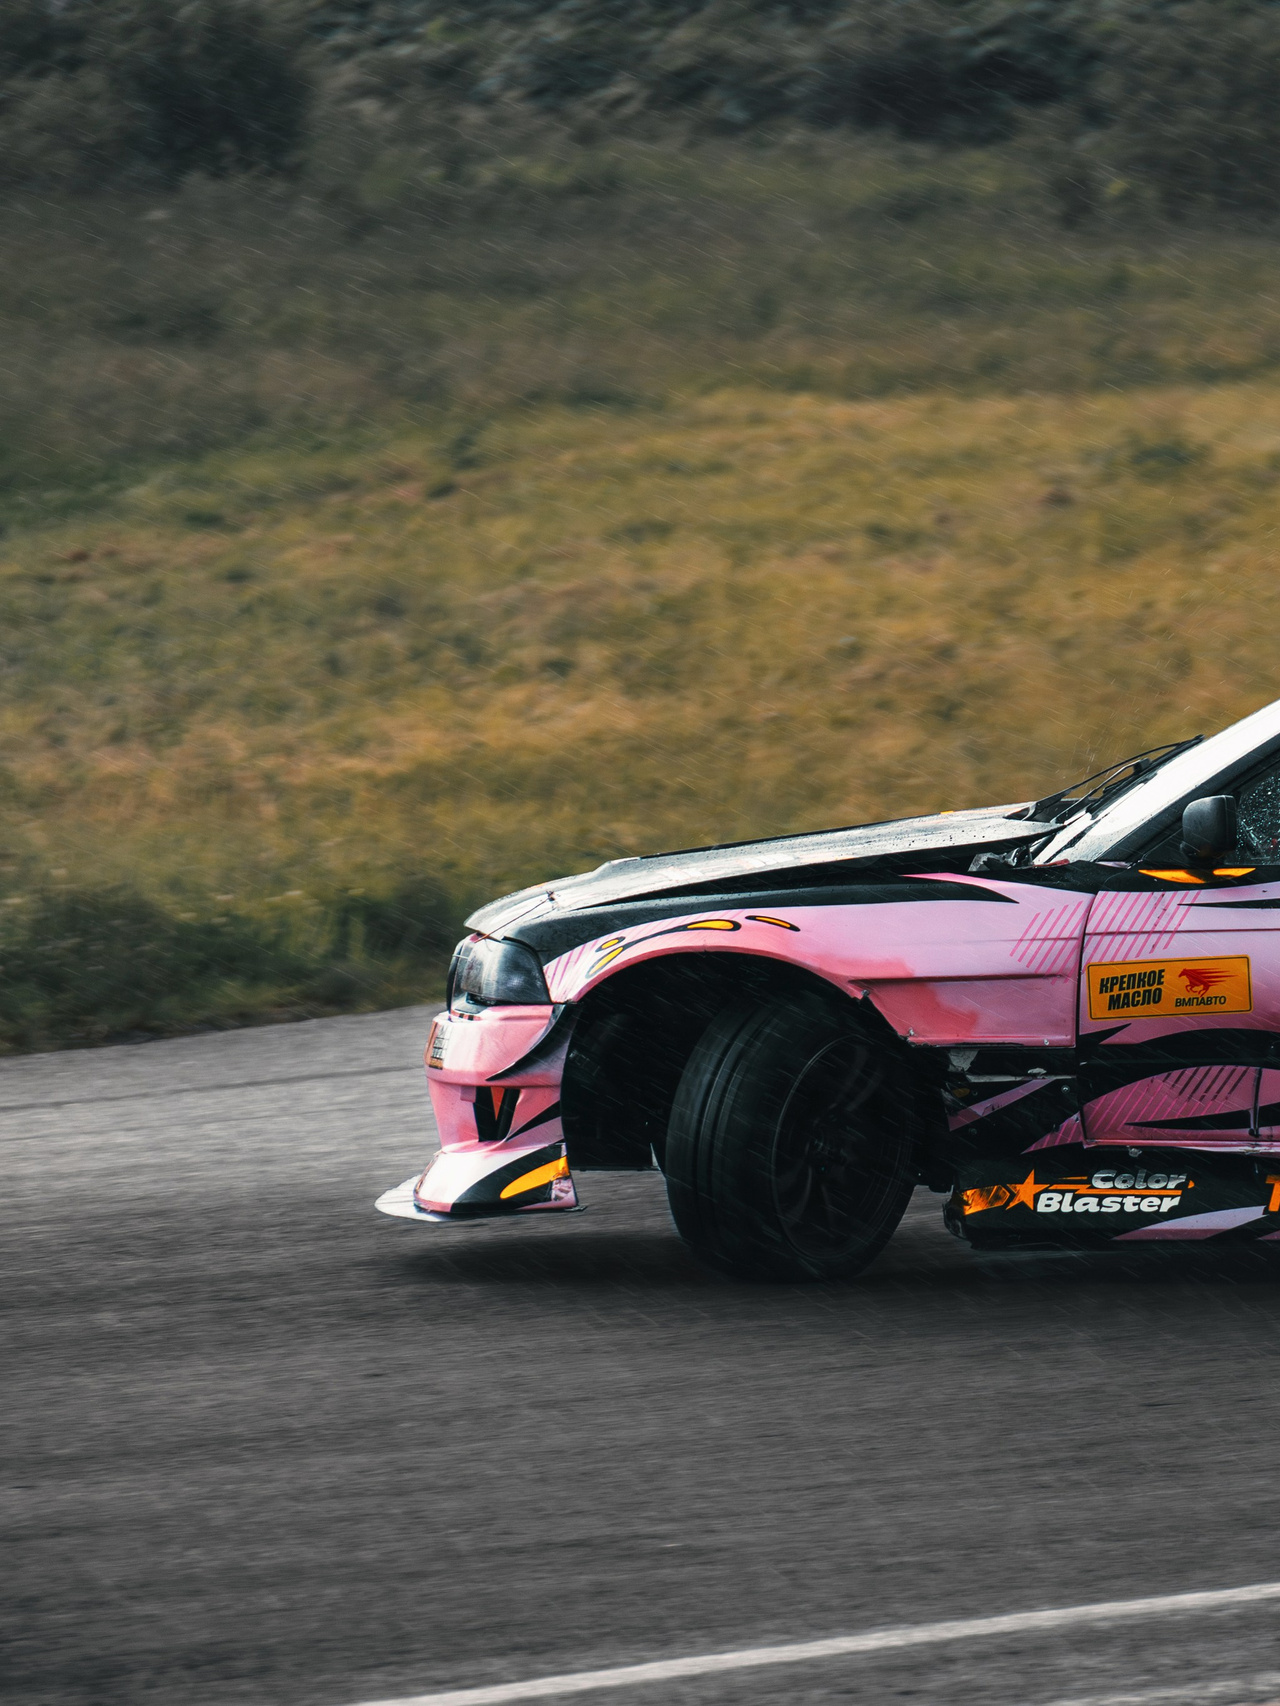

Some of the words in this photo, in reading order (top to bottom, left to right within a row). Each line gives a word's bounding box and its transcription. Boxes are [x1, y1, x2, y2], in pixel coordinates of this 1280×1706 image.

[1099, 969, 1165, 994] КРЕПКОЕ
[1108, 988, 1163, 1011] МАСЛО
[1174, 996, 1227, 1008] ВМПАВТО
[1091, 1169, 1188, 1189] Color
[1037, 1192, 1182, 1213] Blaster
